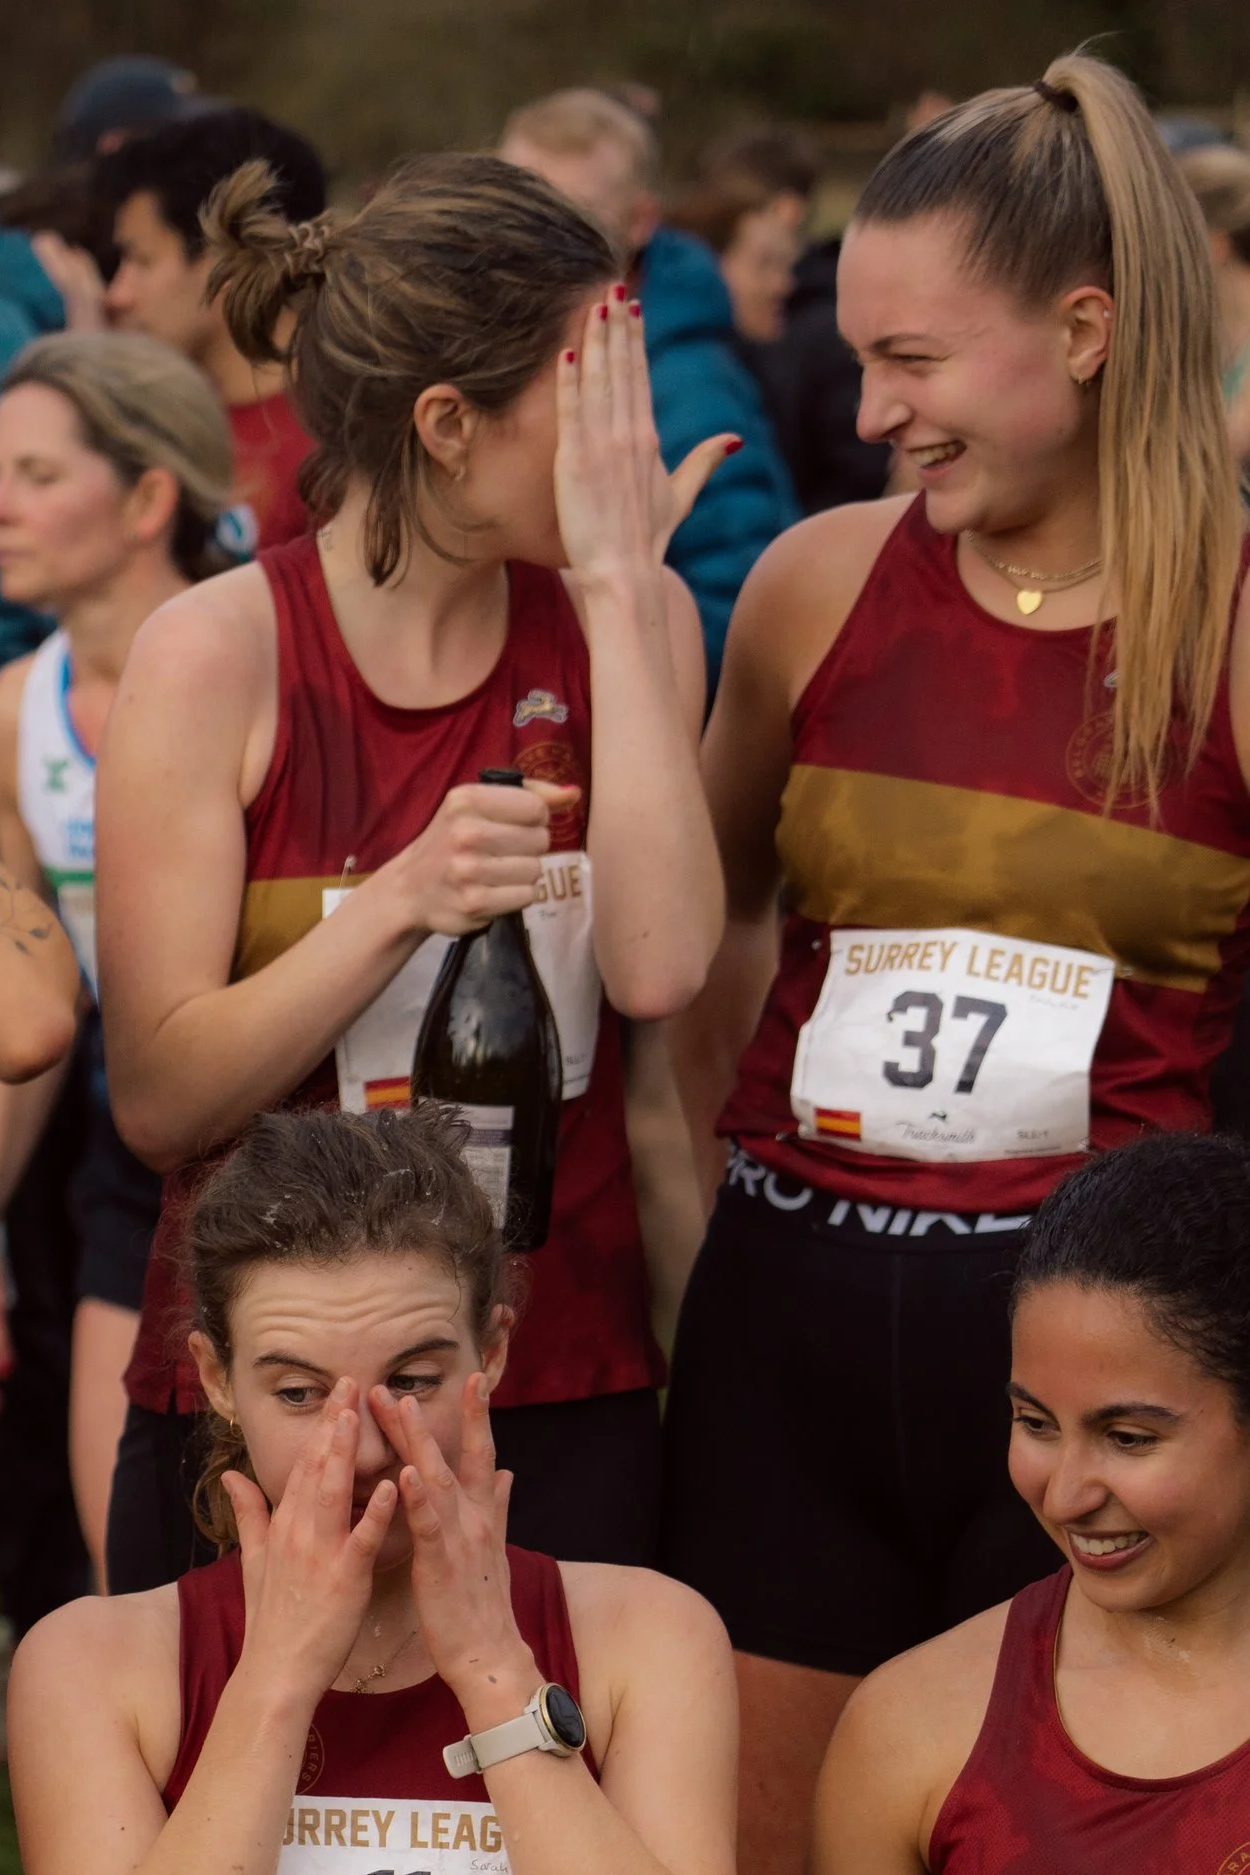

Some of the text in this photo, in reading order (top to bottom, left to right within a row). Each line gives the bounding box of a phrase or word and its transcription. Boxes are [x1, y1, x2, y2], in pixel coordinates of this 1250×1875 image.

[845, 941, 1094, 999] SURREY LEAGUE
[882, 990, 1007, 1095] 37
[896, 1121, 975, 1143] Tracksmith
[301, 1734, 319, 1781] RIERS
[283, 1809, 502, 1853] URREY LEAG
